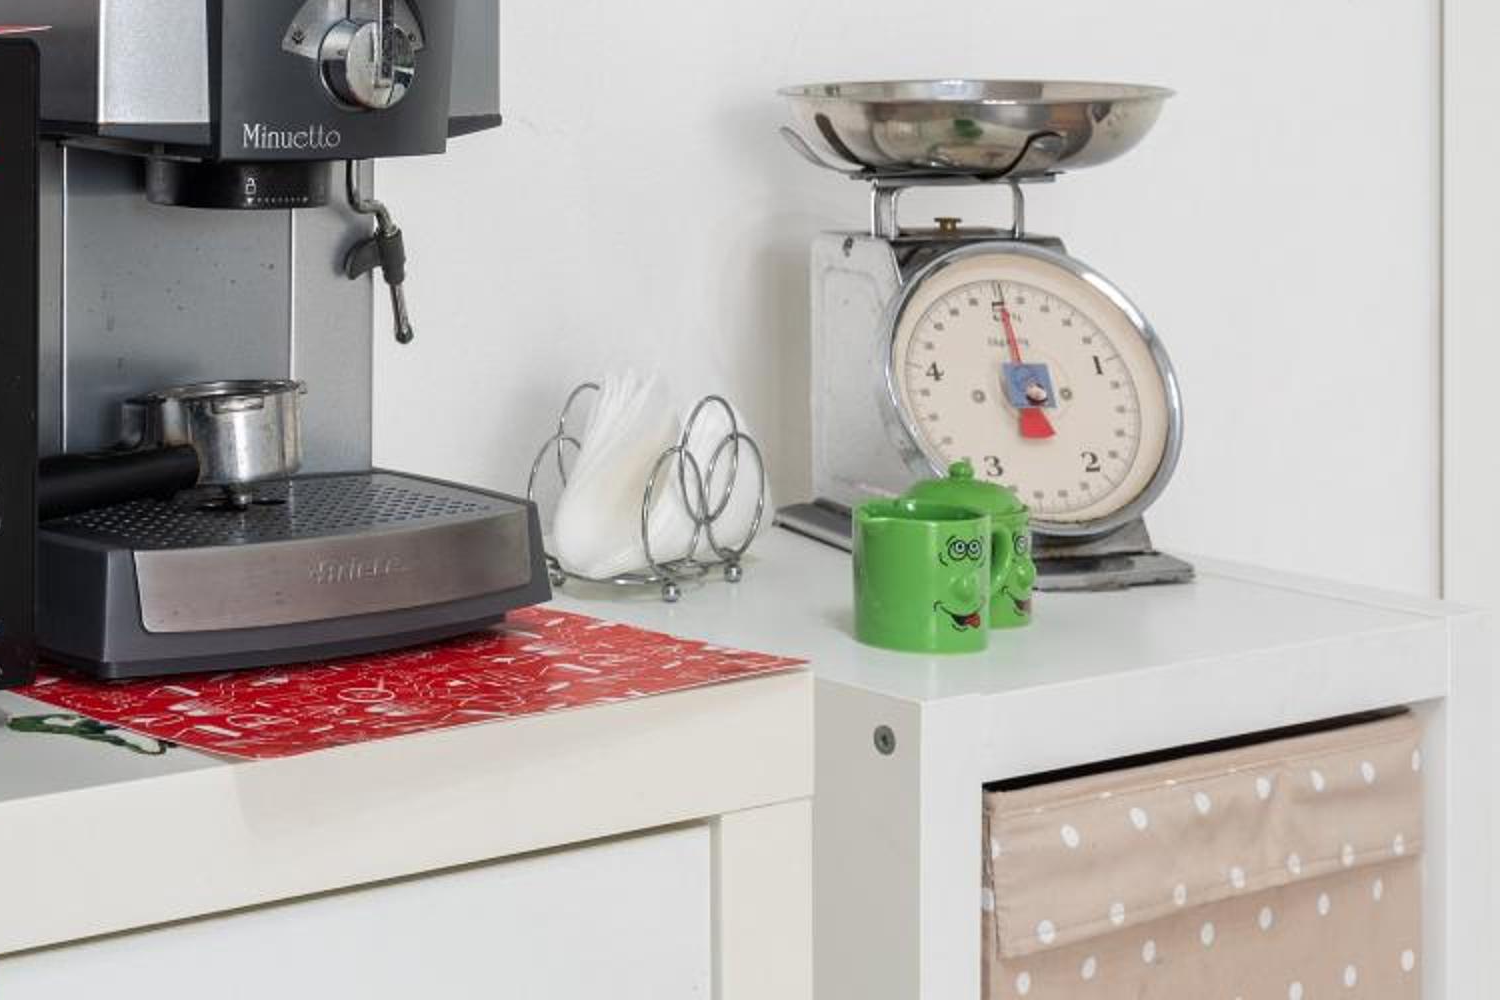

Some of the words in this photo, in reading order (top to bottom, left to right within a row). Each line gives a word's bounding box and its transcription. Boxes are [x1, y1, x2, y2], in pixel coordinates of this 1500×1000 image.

[242, 122, 341, 150] Minuetto
[925, 362, 944, 382] 4
[1092, 354, 1104, 376] 1
[983, 455, 1004, 477] 3
[1080, 451, 1101, 473] 2
